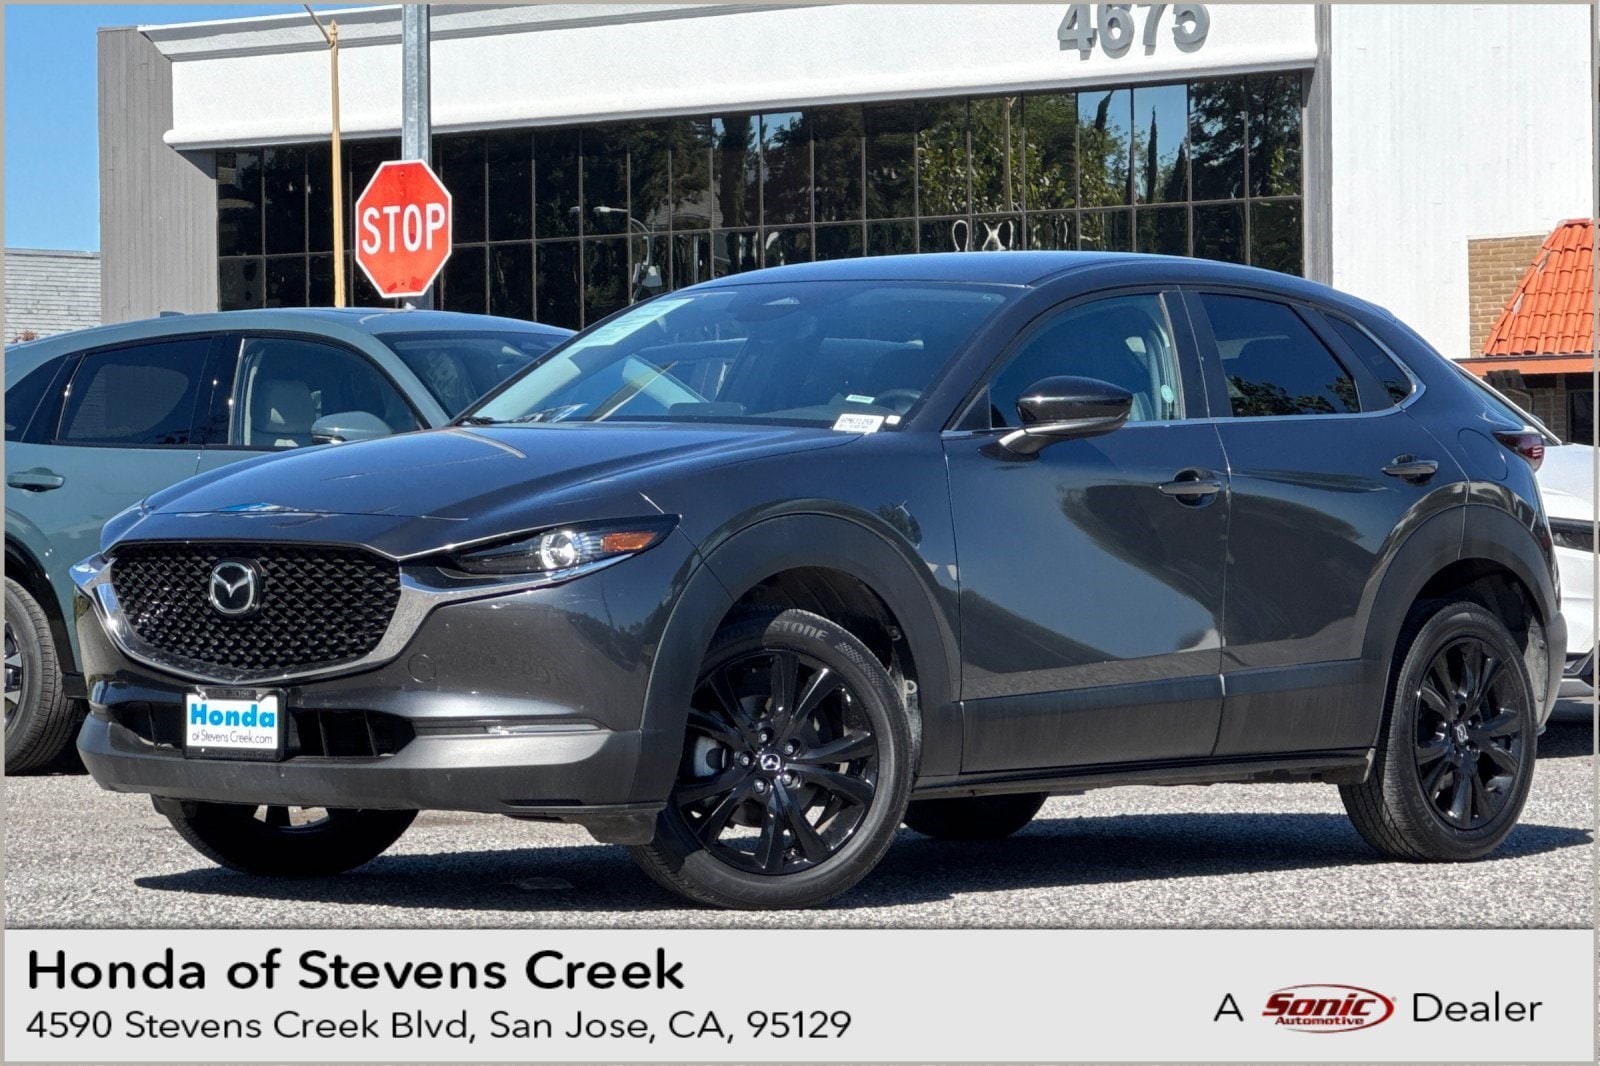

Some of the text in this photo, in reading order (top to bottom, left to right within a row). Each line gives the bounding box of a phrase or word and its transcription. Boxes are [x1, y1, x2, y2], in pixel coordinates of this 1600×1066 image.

[1057, 4, 1210, 60] 4675
[361, 203, 446, 255] STOP
[191, 703, 275, 727] Honda
[192, 729, 273, 744] of Stevens Creek.com
